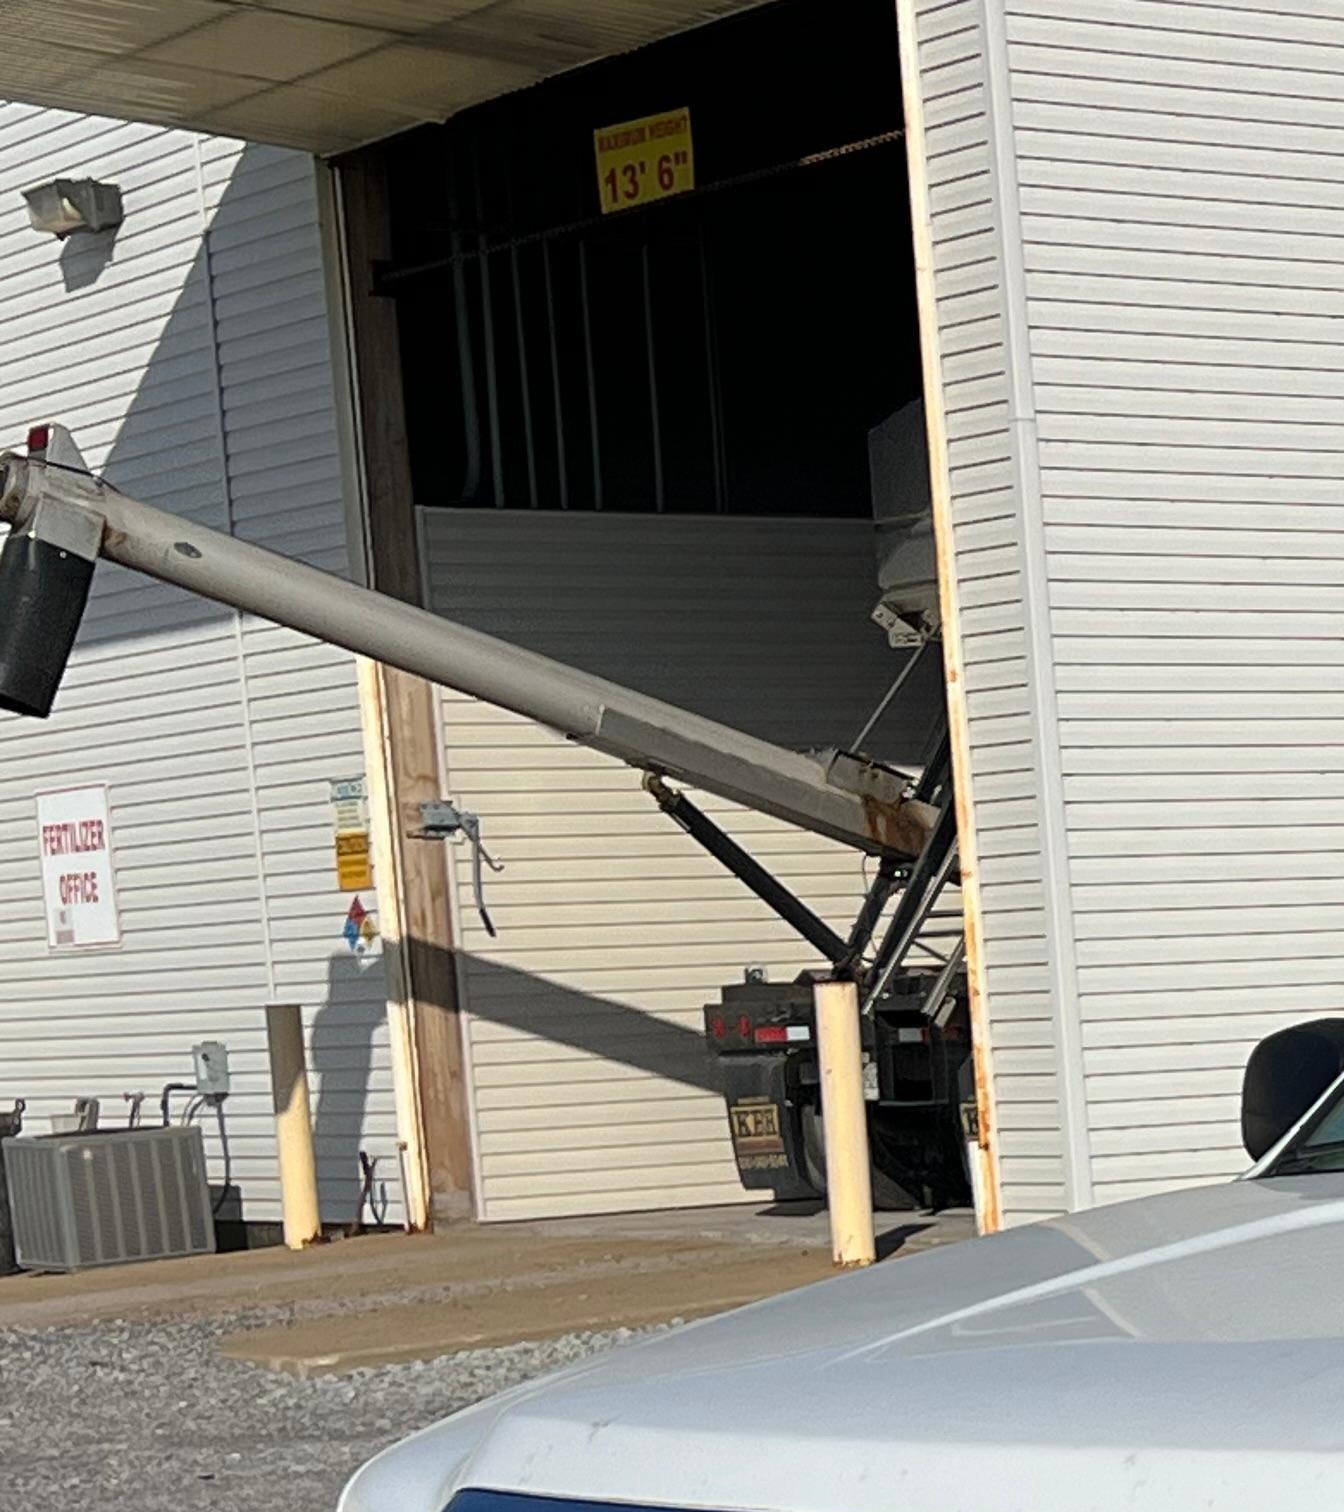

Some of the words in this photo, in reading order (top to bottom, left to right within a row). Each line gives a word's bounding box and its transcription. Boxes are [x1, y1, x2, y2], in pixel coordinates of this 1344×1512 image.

[599, 127, 646, 153] MAXIMUM
[649, 115, 688, 138] HEIGHT
[604, 161, 646, 203] 13'
[658, 150, 688, 191] 6"
[43, 819, 105, 856] FERTILIZER
[60, 872, 98, 904] OFFICE
